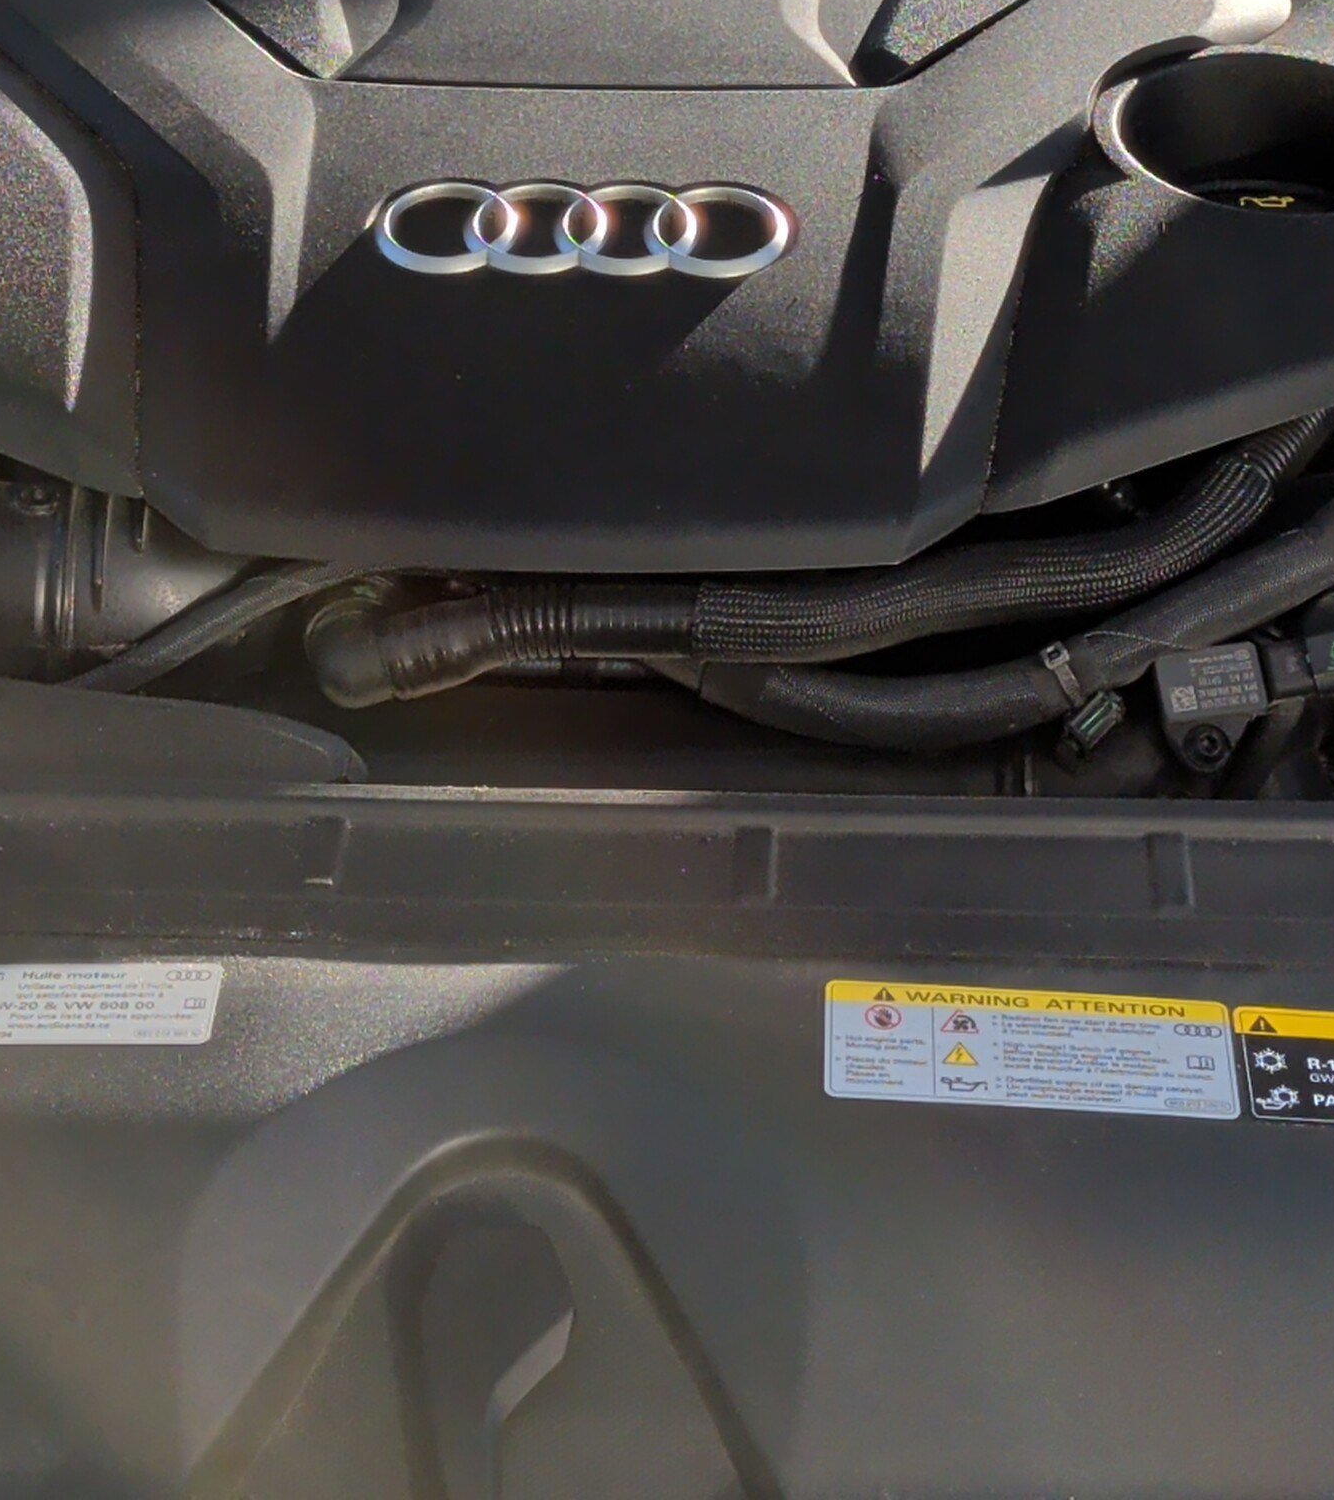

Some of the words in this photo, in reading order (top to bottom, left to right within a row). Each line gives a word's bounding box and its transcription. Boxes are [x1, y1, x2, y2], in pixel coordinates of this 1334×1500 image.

[22, 971, 62, 980] Huile
[67, 972, 127, 980] moteur
[44, 1001, 57, 1011] &
[64, 1001, 94, 1010] VW
[135, 1001, 155, 1010] 00
[906, 990, 1030, 1009] WARNING
[1045, 997, 1186, 1018] ATTENTION
